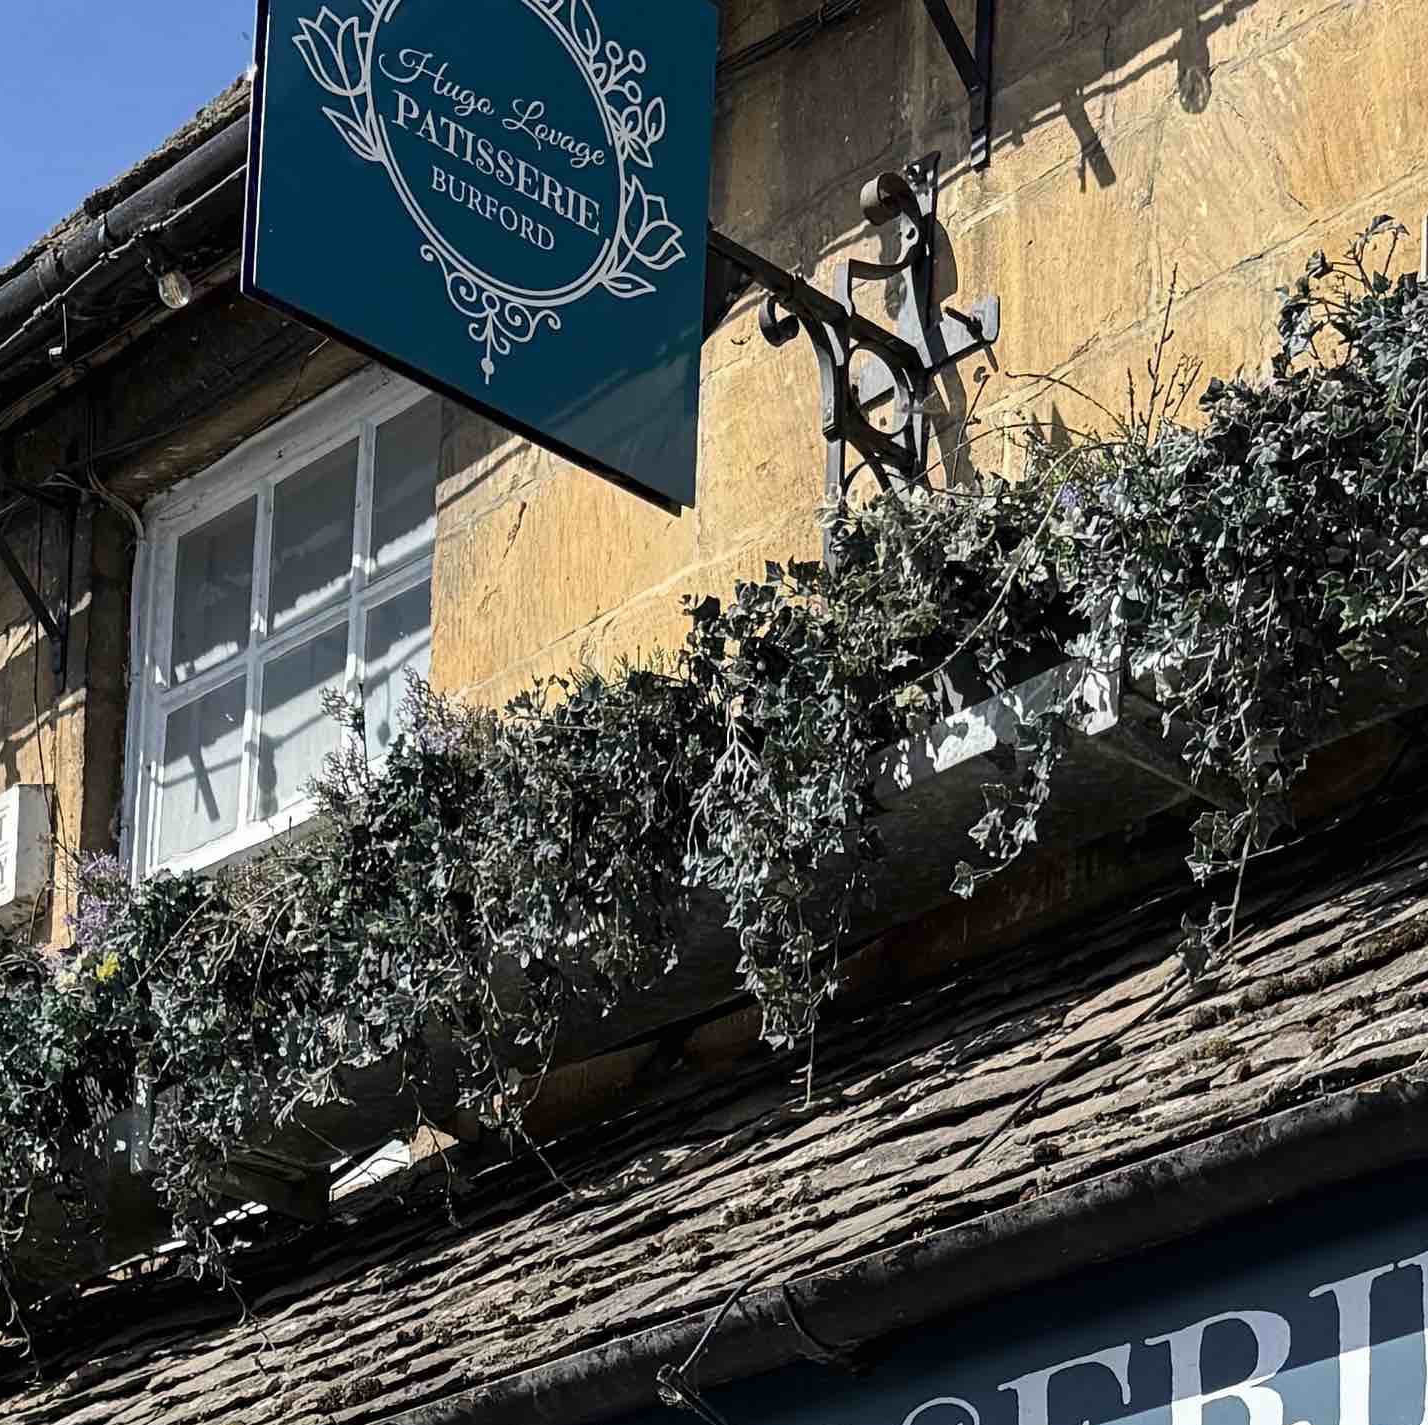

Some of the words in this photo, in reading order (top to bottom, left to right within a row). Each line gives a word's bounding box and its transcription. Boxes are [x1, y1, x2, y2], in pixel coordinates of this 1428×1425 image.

[378, 48, 496, 117] Hugo
[501, 99, 606, 168] Lovage
[391, 90, 602, 235] PATISSERIE
[430, 166, 556, 251] BURFORD
